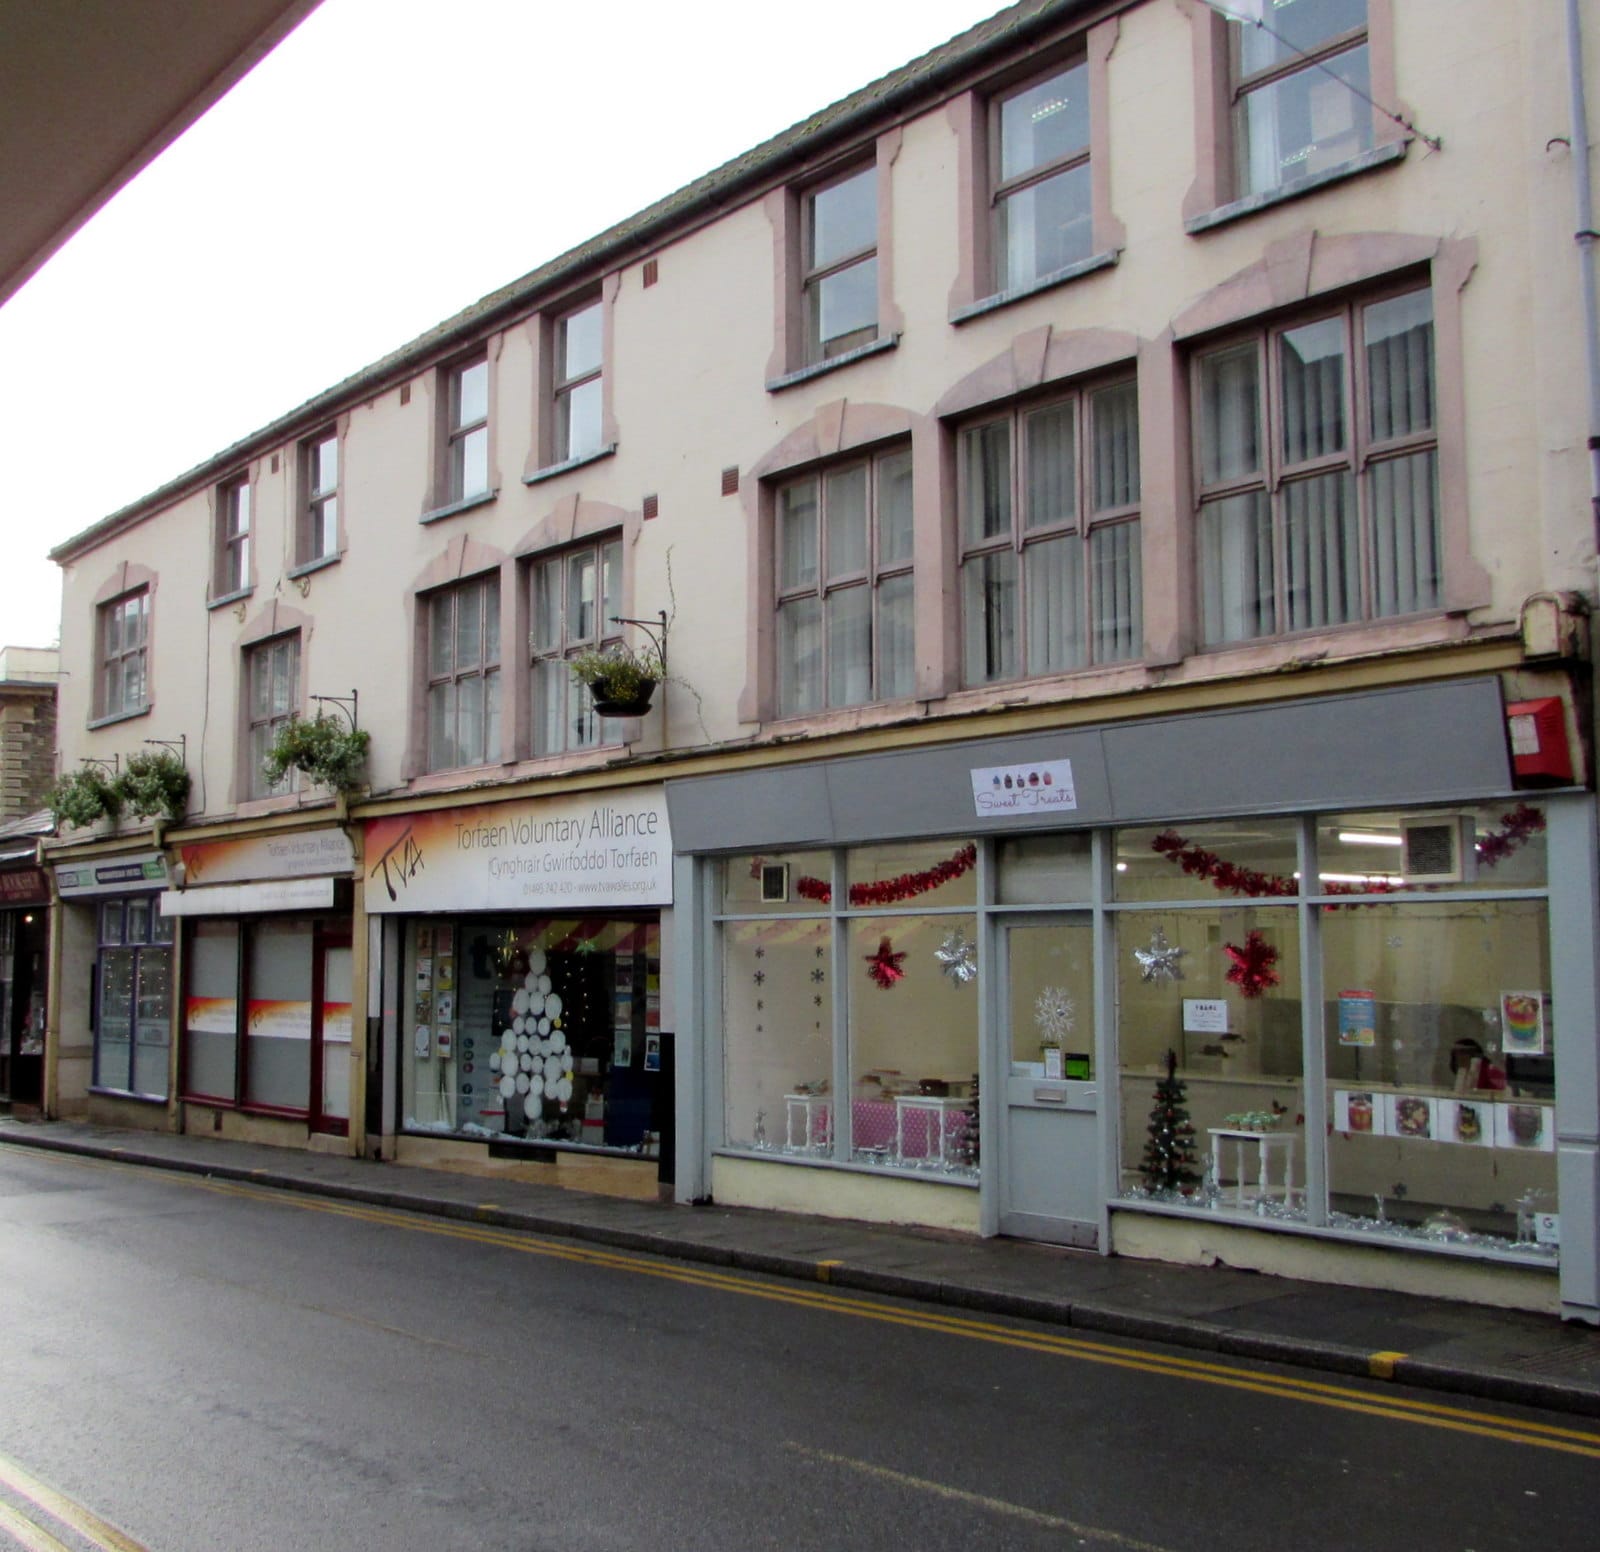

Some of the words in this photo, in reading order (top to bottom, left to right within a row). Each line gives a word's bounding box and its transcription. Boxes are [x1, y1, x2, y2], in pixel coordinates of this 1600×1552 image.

[977, 792, 1021, 809] Sweet
[1022, 788, 1073, 806] Treats
[455, 820, 507, 849] Torfaen
[510, 816, 586, 848] Voluntary
[588, 807, 658, 839] Alliance
[371, 825, 425, 901] TVA
[490, 854, 540, 879] Cynghrair
[543, 849, 607, 872] Gwirfoddol
[611, 847, 658, 868] Torfaen
